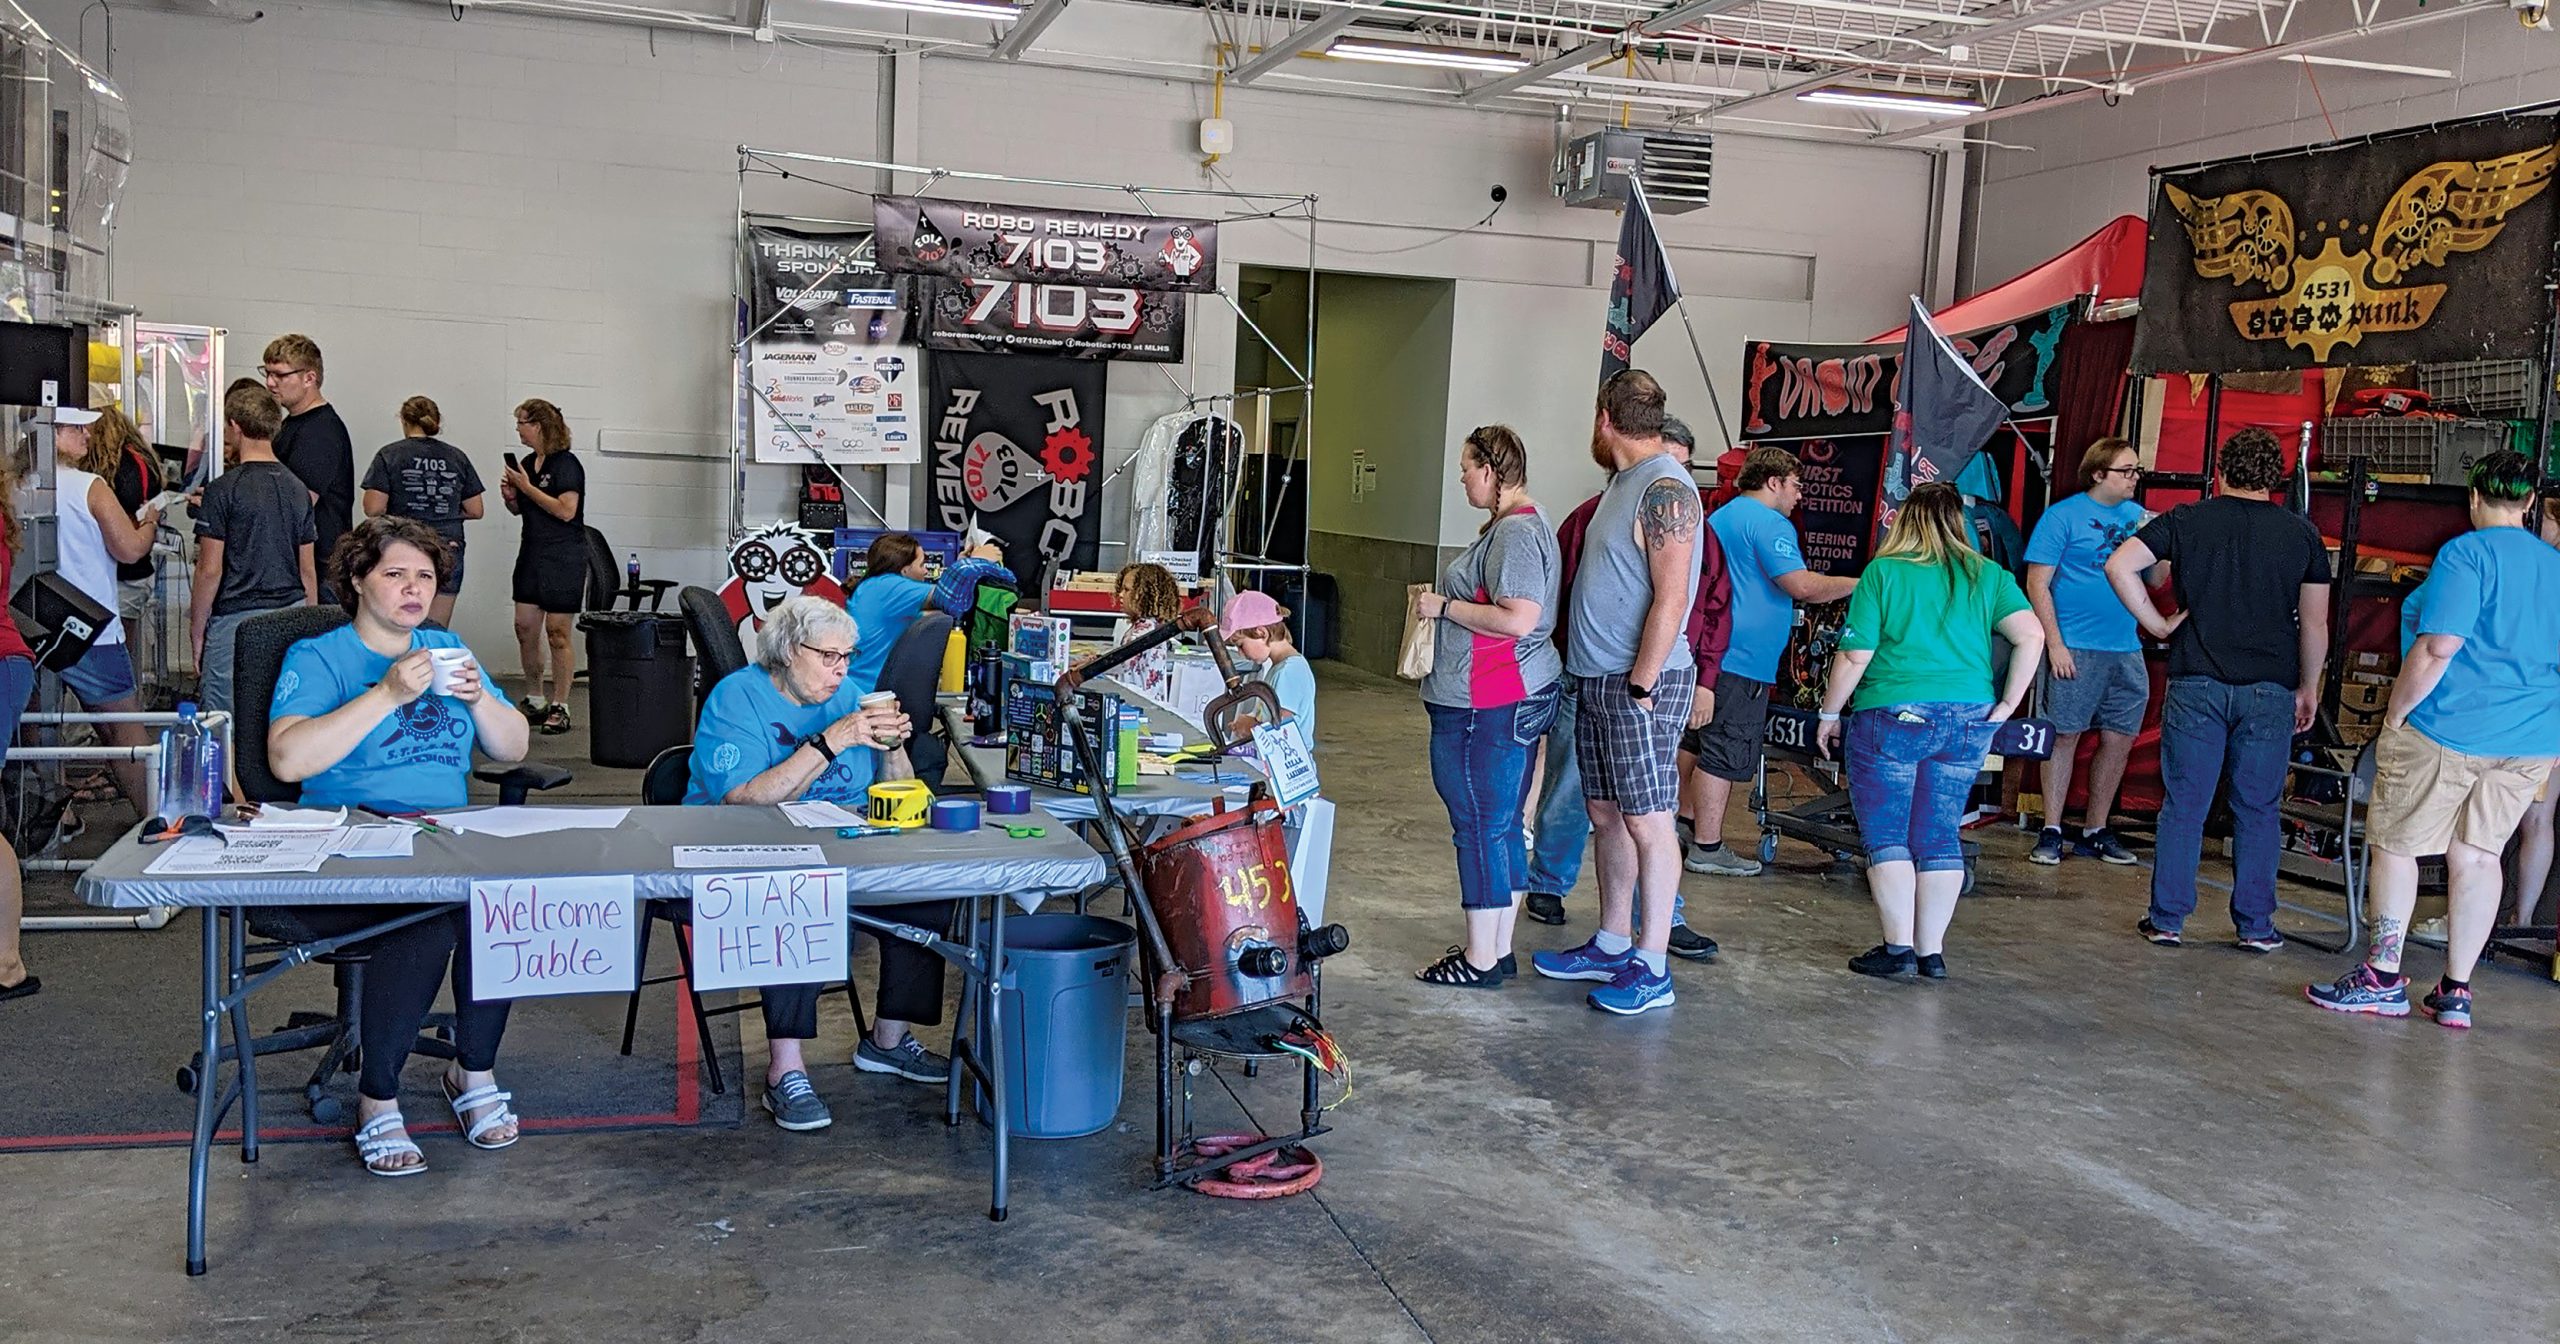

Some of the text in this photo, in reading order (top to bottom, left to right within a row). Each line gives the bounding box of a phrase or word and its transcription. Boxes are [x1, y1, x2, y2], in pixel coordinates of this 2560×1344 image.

[963, 212, 1147, 241] ROBO REMEDY
[758, 242, 839, 259] THANK
[1001, 234, 1108, 272] 7103
[850, 294, 893, 305] FASTENAL
[2303, 281, 2350, 300] 4531
[966, 278, 1140, 332] 7103
[2346, 292, 2422, 336] punk
[932, 330, 1002, 343] roboremedy.org
[1145, 344, 1170, 352] MLHS
[762, 353, 817, 361] JAGEMANN
[413, 458, 447, 471] 7103
[934, 388, 982, 533] REMED
[1803, 465, 1842, 482] IRST
[1801, 482, 1853, 498] BOTICS
[1800, 499, 1863, 514] PETITION
[1806, 531, 1857, 548] EERING
[1806, 546, 1853, 560] RATION
[1806, 560, 1831, 571] ARD
[1764, 713, 1806, 747] 4531
[2018, 724, 2046, 755] 31
[699, 872, 842, 920] START
[478, 883, 622, 934] Welcome
[719, 922, 834, 973] HERE
[490, 938, 612, 983] Table
